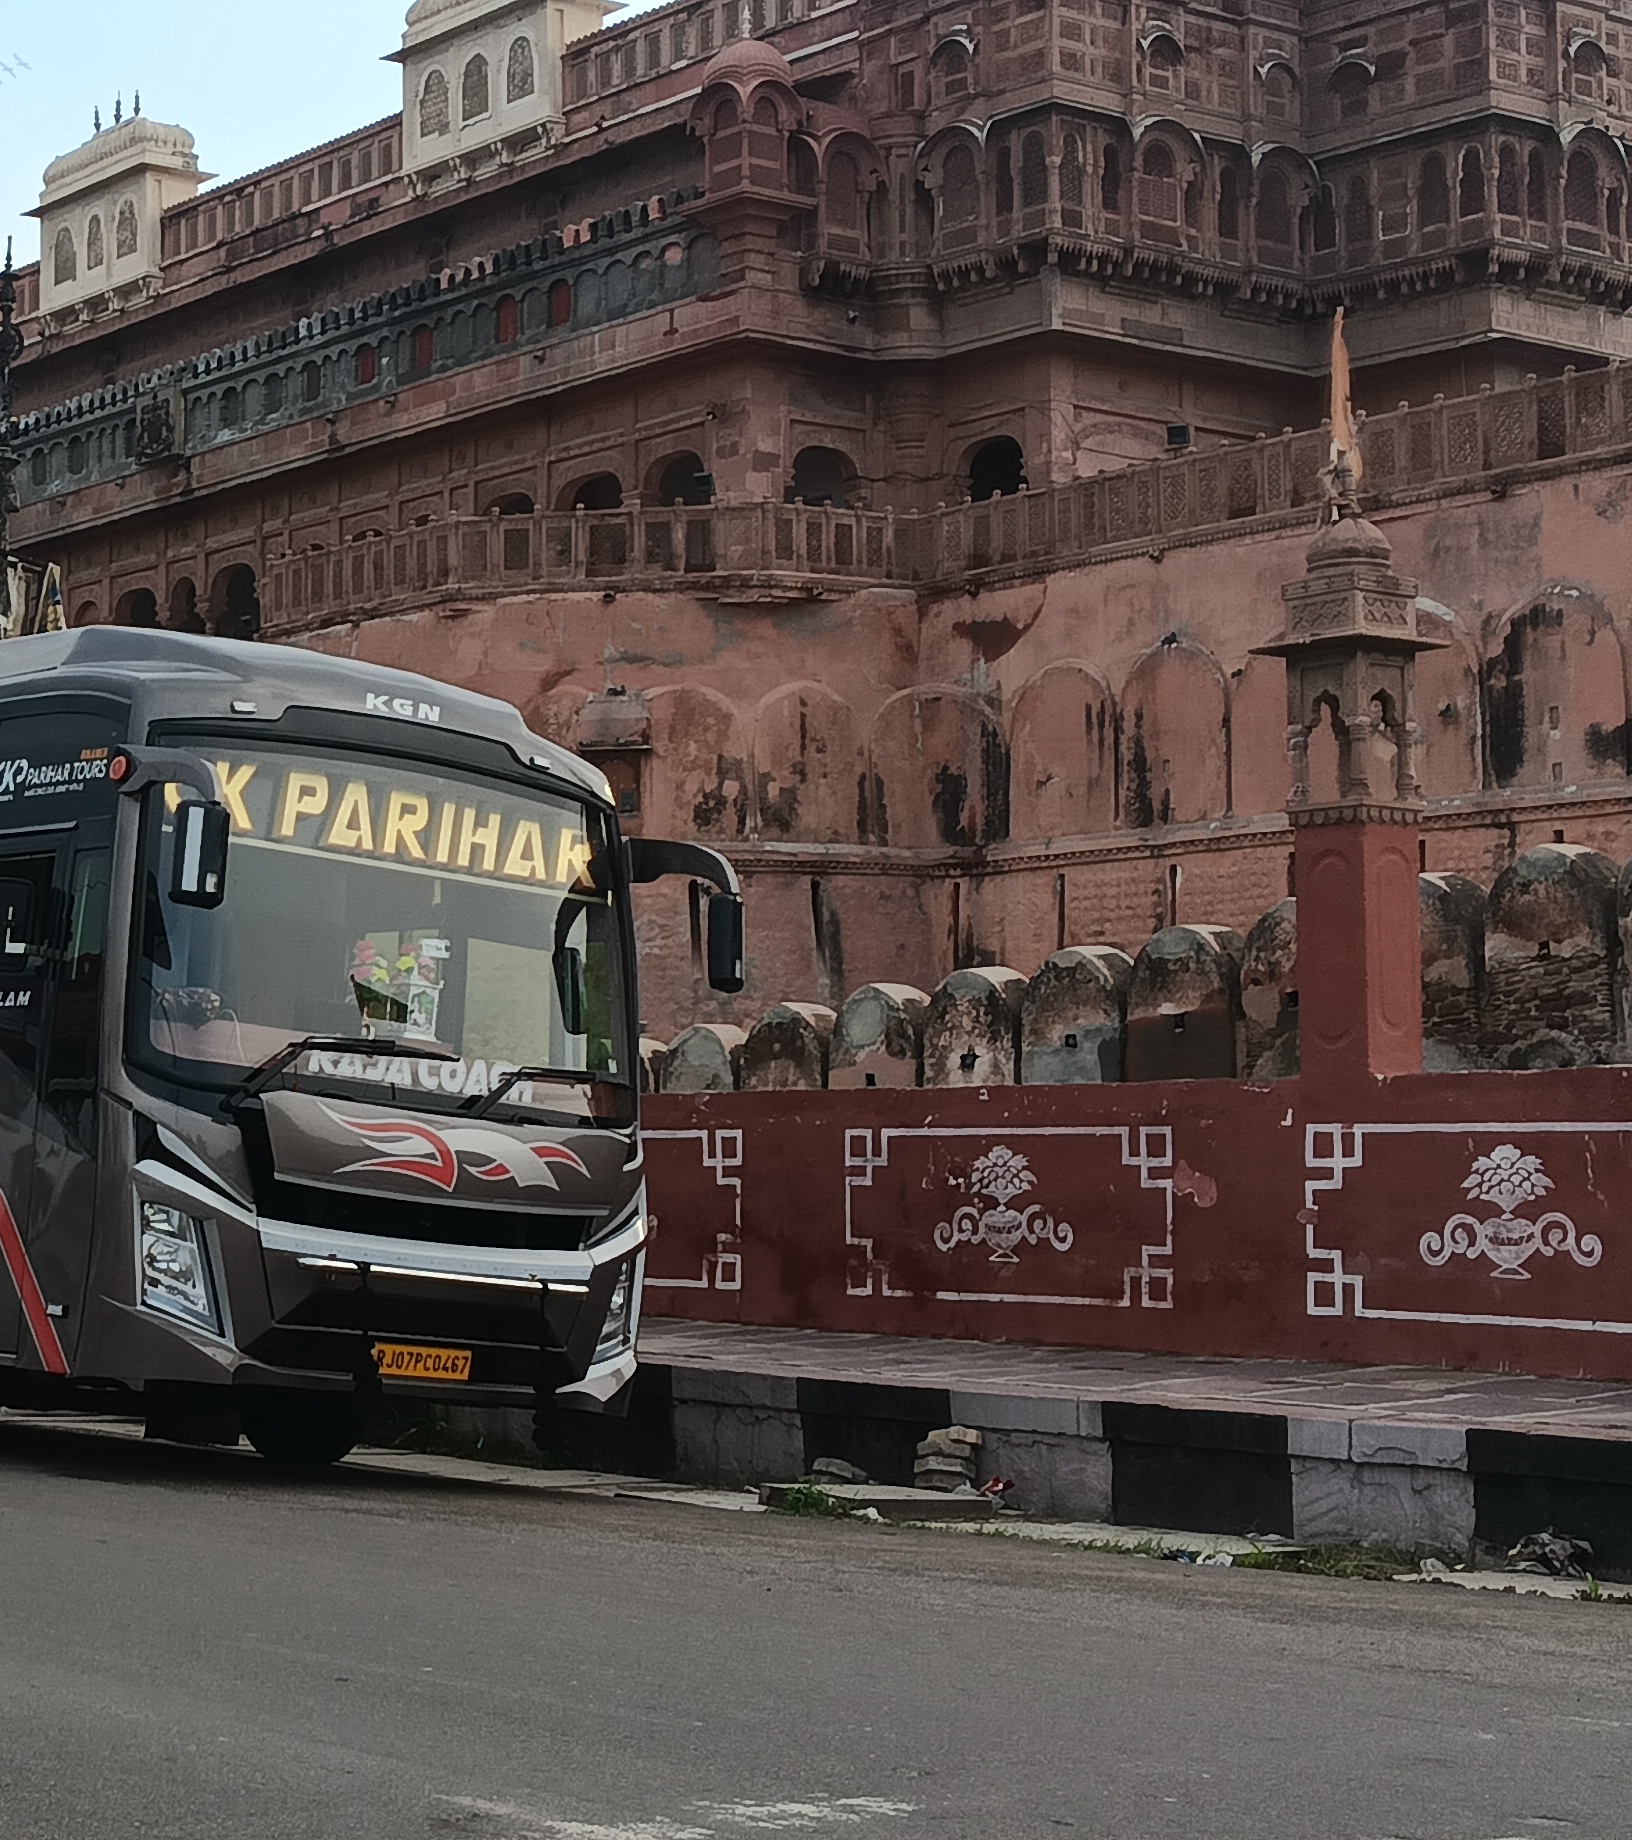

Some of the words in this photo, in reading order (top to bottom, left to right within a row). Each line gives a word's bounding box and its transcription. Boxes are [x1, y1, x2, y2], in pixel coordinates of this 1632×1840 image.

[366, 693, 441, 722] KGN
[71, 759, 108, 780] TOURS
[274, 771, 597, 888] PARIHAR
[376, 1349, 470, 1375] RJ07PC0467
